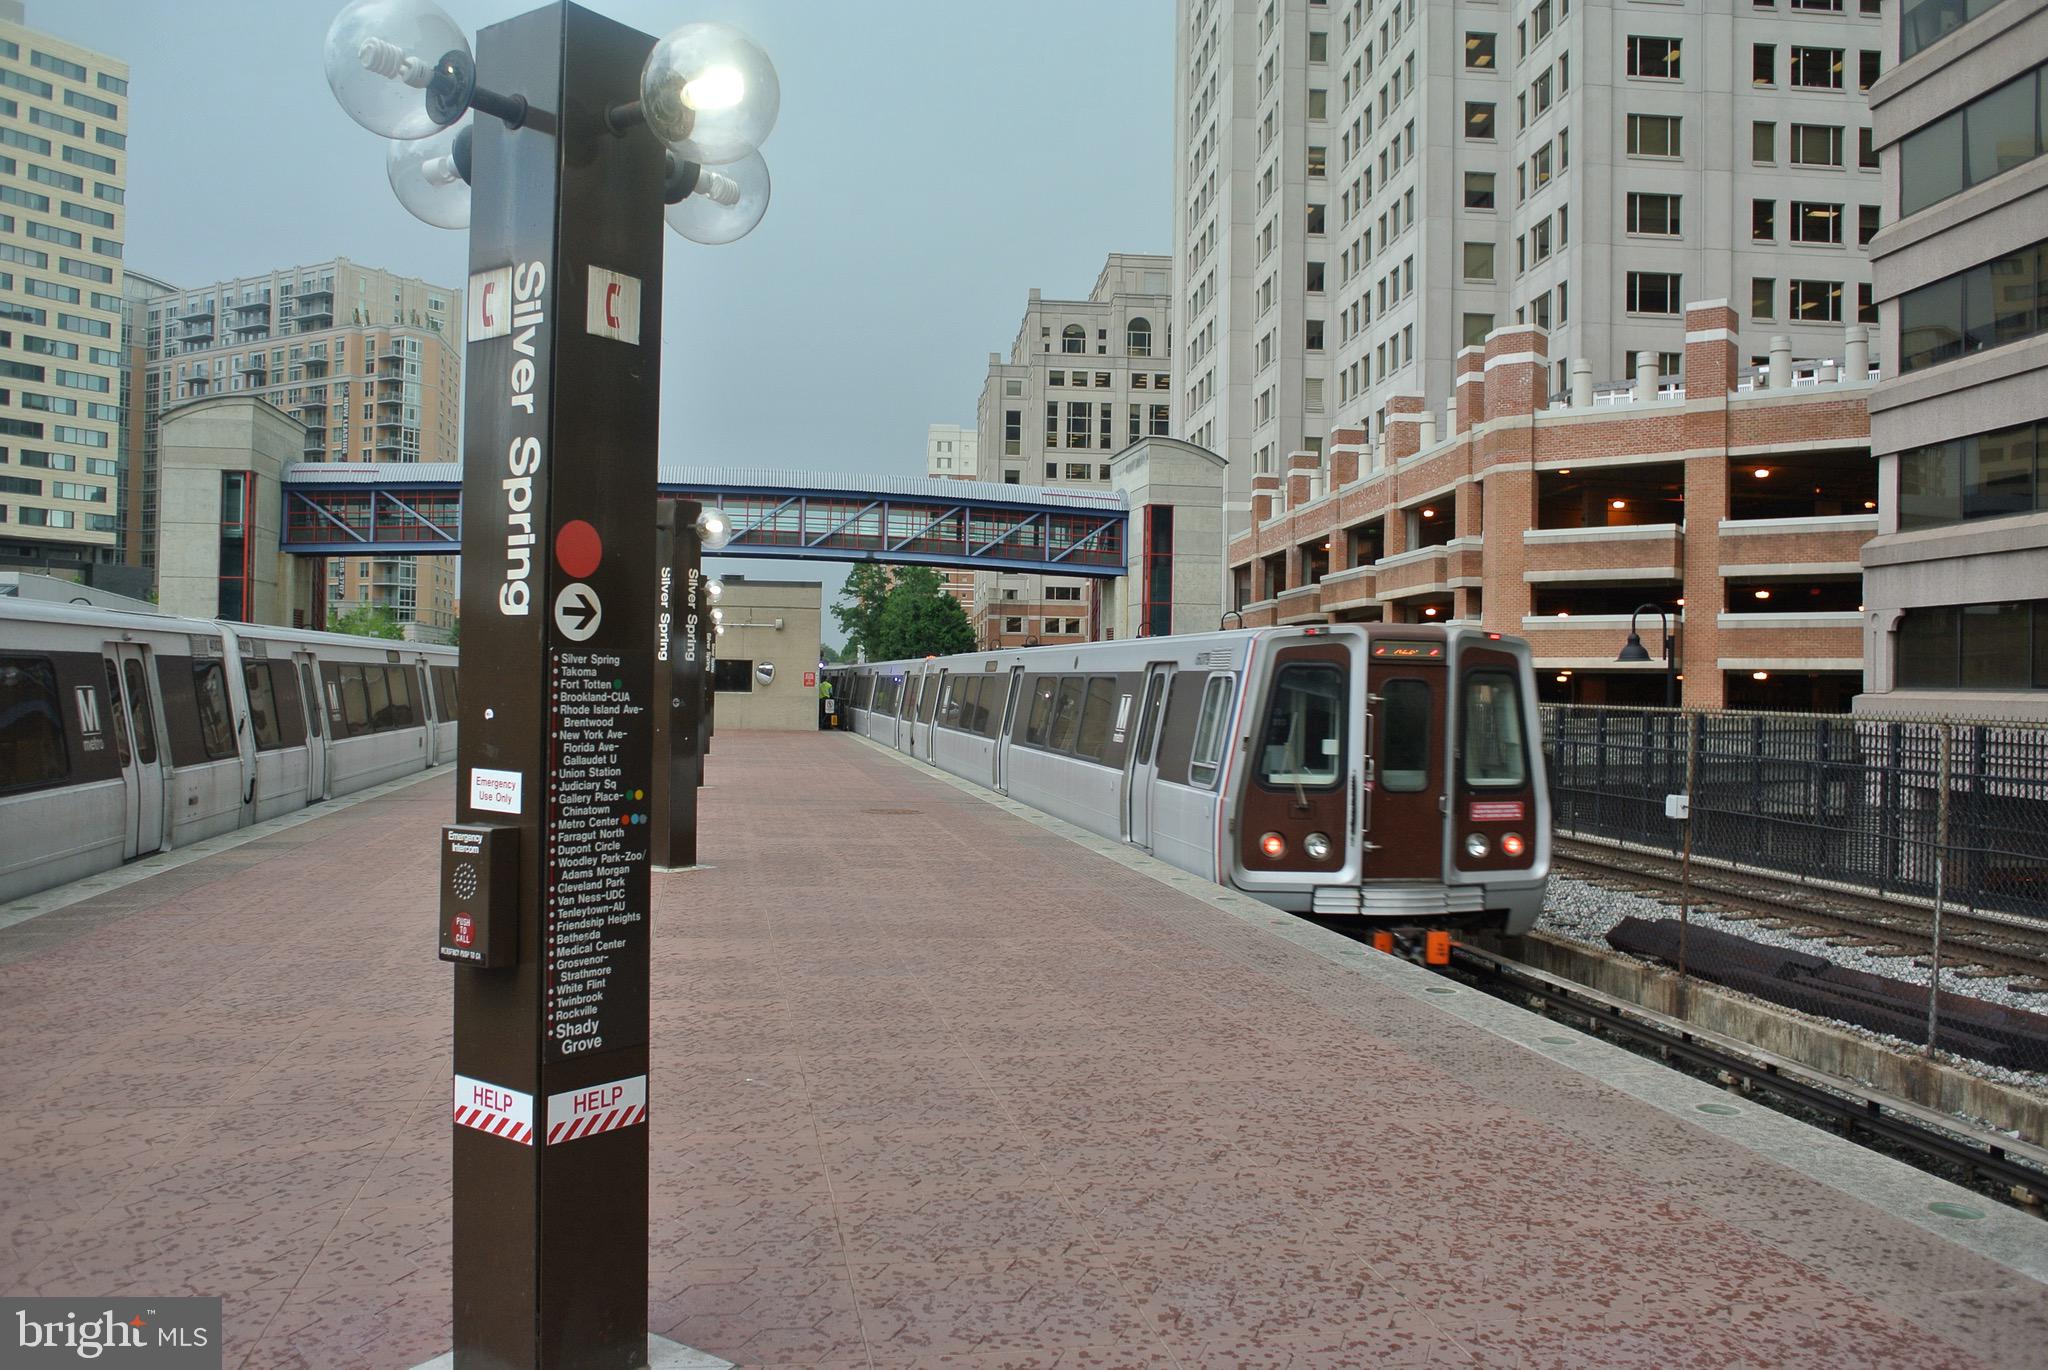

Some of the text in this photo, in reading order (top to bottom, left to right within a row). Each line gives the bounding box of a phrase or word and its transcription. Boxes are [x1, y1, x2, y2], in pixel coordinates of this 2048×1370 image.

[499, 260, 546, 616] Silver Spring
[657, 567, 671, 661] Silver Spring
[684, 568, 699, 662] Silver Spring
[561, 653, 620, 666] Silver Spring
[561, 666, 597, 676] Takoma
[560, 679, 612, 689] Fort Totten
[560, 692, 631, 702] Brookland-CUA
[560, 704, 644, 714] Rhode Island Ave-
[564, 717, 614, 727] Brentwood
[560, 729, 628, 740] New York Ave-
[563, 742, 620, 752] Florida Ave-
[563, 754, 617, 766] Gallaudet U
[559, 767, 622, 778] Union Station
[476, 776, 516, 791] Emergency
[559, 779, 617, 792] Judiciary Sq
[480, 791, 512, 804] Use Only
[559, 792, 624, 804] Gallery Place-
[562, 806, 610, 816] Chinatown
[558, 817, 620, 830] Metro Center
[448, 830, 483, 845] Emergency
[558, 828, 625, 842] Farragut North
[452, 842, 480, 854] Intercom
[558, 841, 621, 856] Dupont Circle
[558, 849, 647, 868] Woodley Park-Zoo/
[561, 866, 630, 881] Adams Morgan
[558, 878, 626, 894] Cleveland Park
[558, 889, 626, 906] Van Ness-UDC
[558, 902, 626, 919] Tenleytown-AU
[556, 912, 641, 932] Friendship Heights
[460, 926, 468, 935] TO
[556, 930, 600, 944] Bethesda
[456, 934, 470, 944] CALL
[556, 940, 626, 958] Medical Center
[556, 956, 609, 970] Grosvenor-
[560, 966, 612, 982] Strathmore
[556, 978, 607, 995] White Flint
[556, 991, 604, 1008] Twinbrook
[556, 1005, 598, 1020] Rockville
[556, 1018, 600, 1039] Shady
[562, 1036, 602, 1054] Grove
[473, 1085, 513, 1113] HELP
[573, 1086, 623, 1114] HELP
